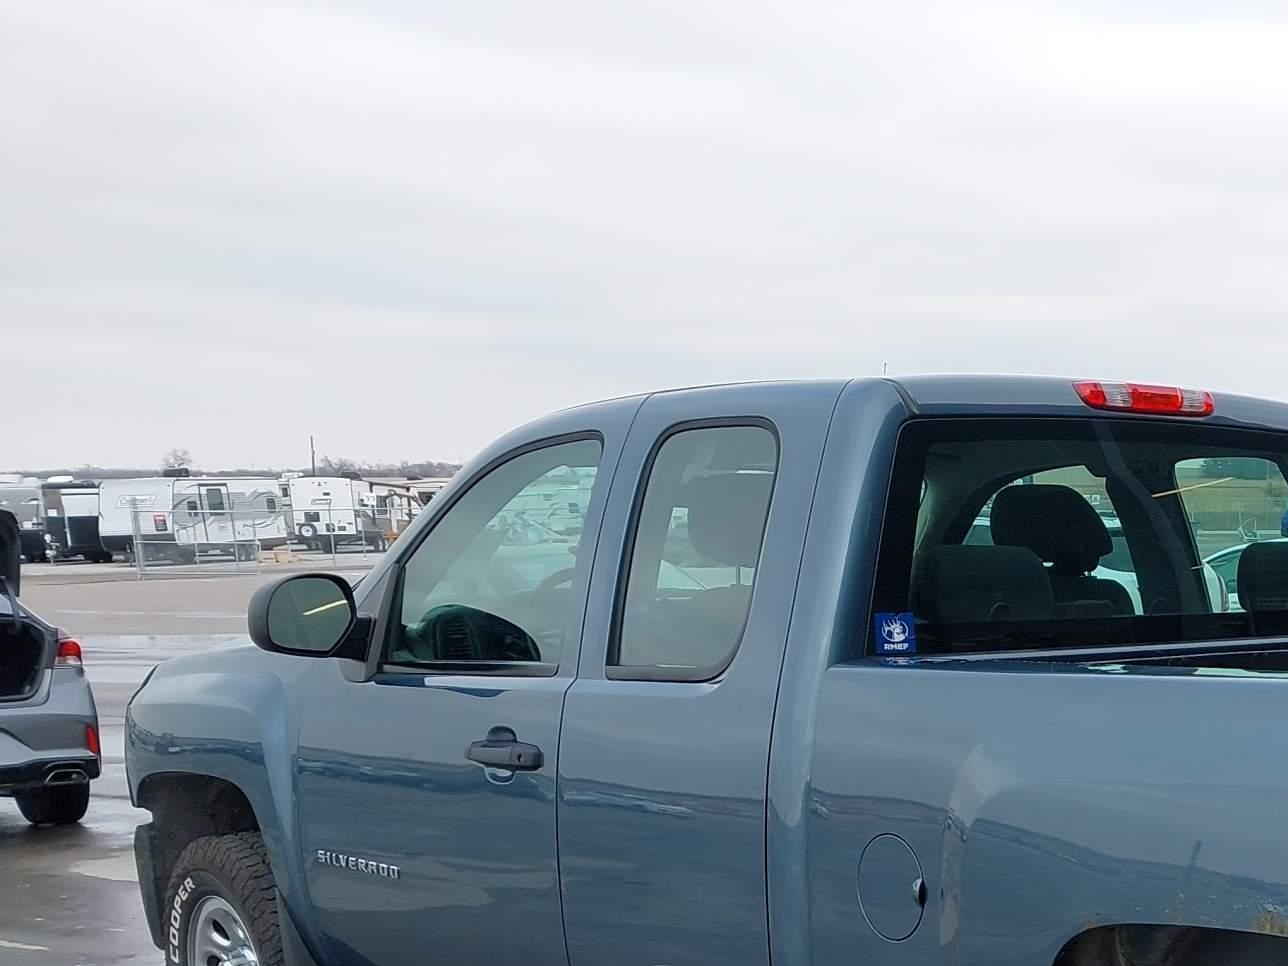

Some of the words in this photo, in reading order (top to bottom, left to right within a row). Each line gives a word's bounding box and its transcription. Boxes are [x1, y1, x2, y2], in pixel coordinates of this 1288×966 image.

[883, 642, 909, 651] RMEF
[317, 850, 400, 879] SILVERADO
[169, 876, 196, 964] COOPER
